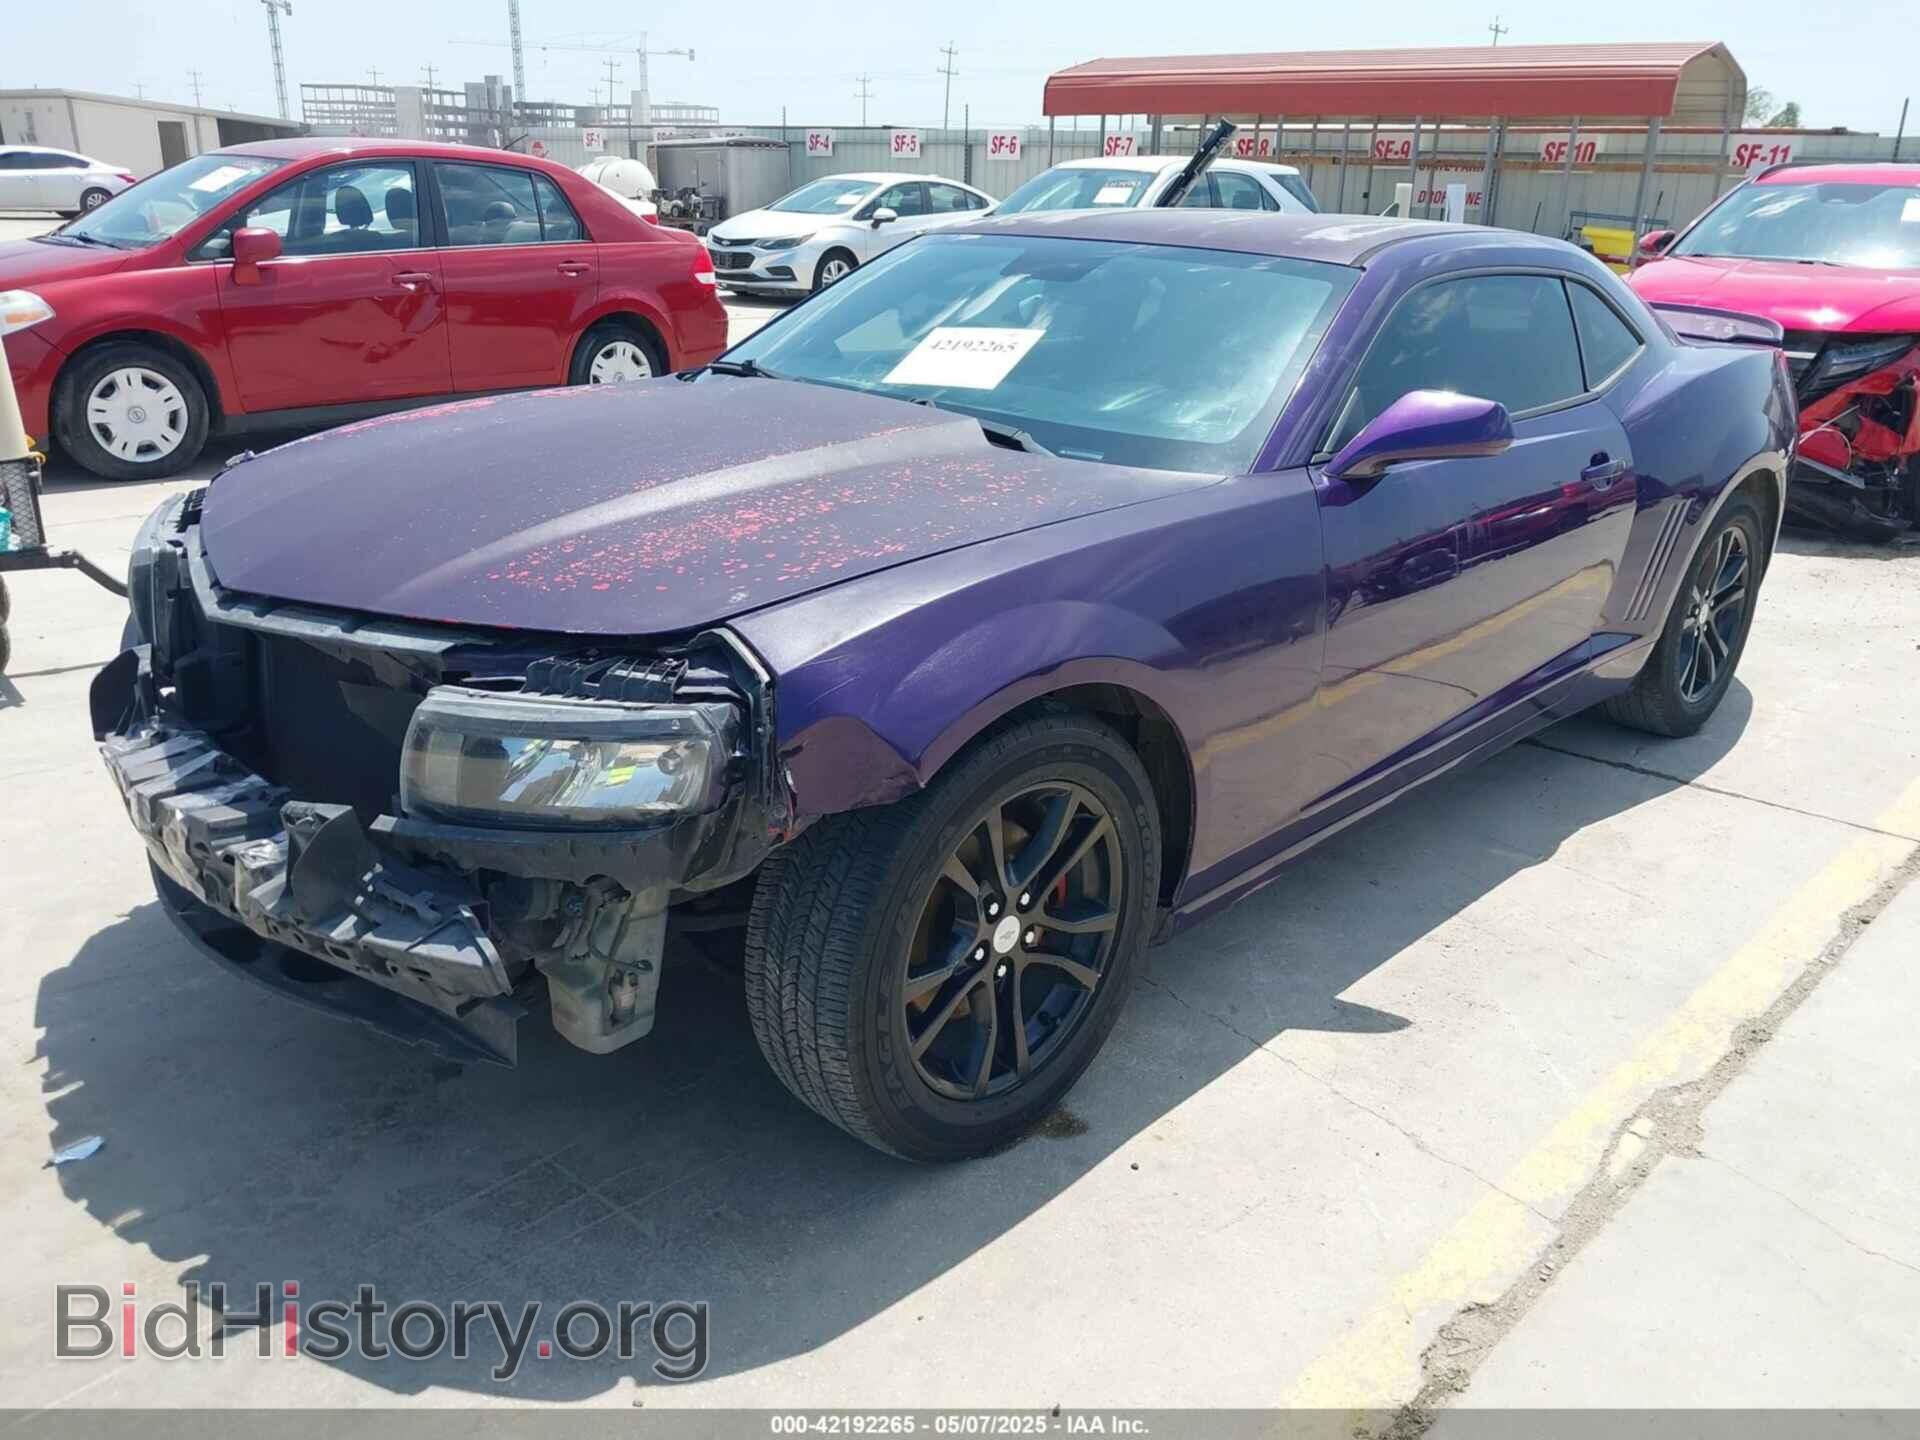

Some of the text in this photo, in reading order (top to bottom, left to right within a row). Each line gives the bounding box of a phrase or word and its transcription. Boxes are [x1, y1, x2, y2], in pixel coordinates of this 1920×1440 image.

[808, 134, 830, 151] SF-4
[894, 135, 916, 152] SF-5
[991, 135, 1017, 154] SF-6
[1105, 136, 1133, 156] SF-7
[1236, 139, 1269, 156] SF8
[1375, 140, 1411, 160] SF-9
[1542, 141, 1596, 163] SF10
[1732, 143, 1792, 167] SF-11
